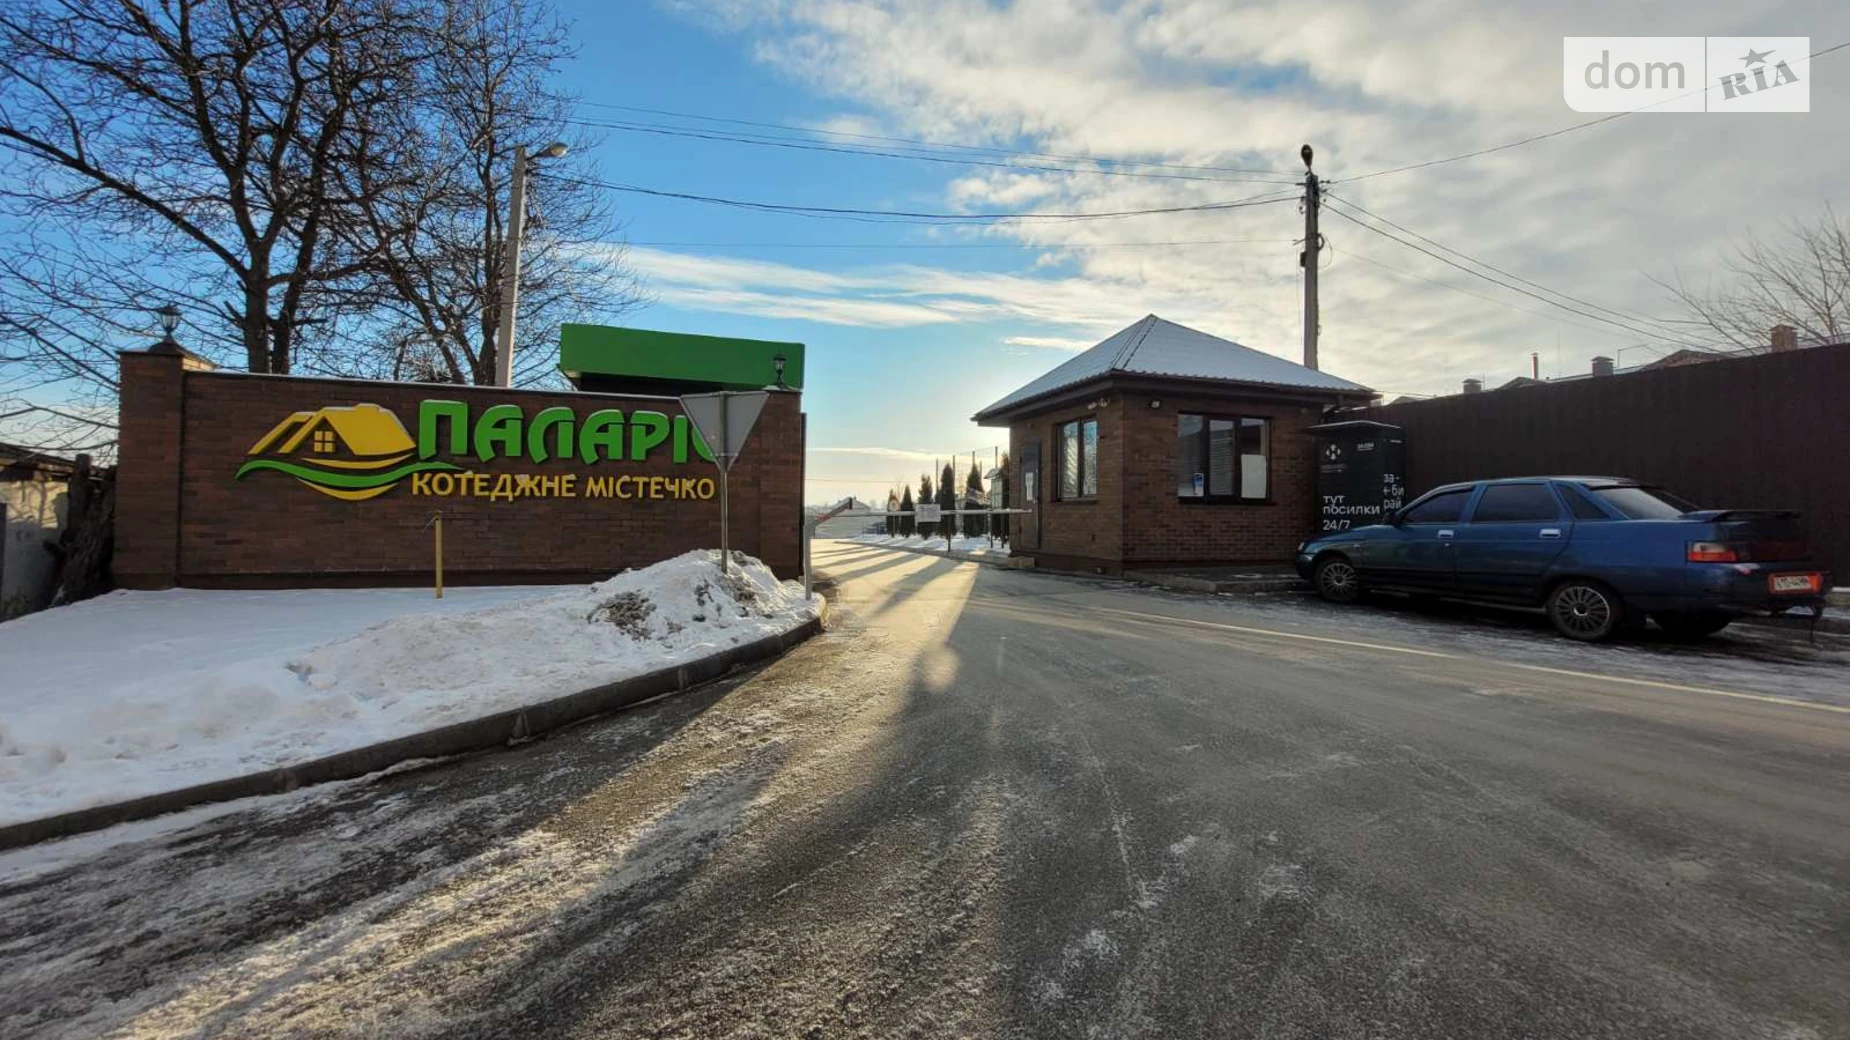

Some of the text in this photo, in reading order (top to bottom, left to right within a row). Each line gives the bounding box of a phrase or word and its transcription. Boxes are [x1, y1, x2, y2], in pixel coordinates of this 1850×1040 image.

[411, 471, 716, 502] КОТЕДЖНЕ МІСТЕЧКО
[1323, 505, 1380, 515] посилки
[1323, 519, 1351, 531] 24/7
